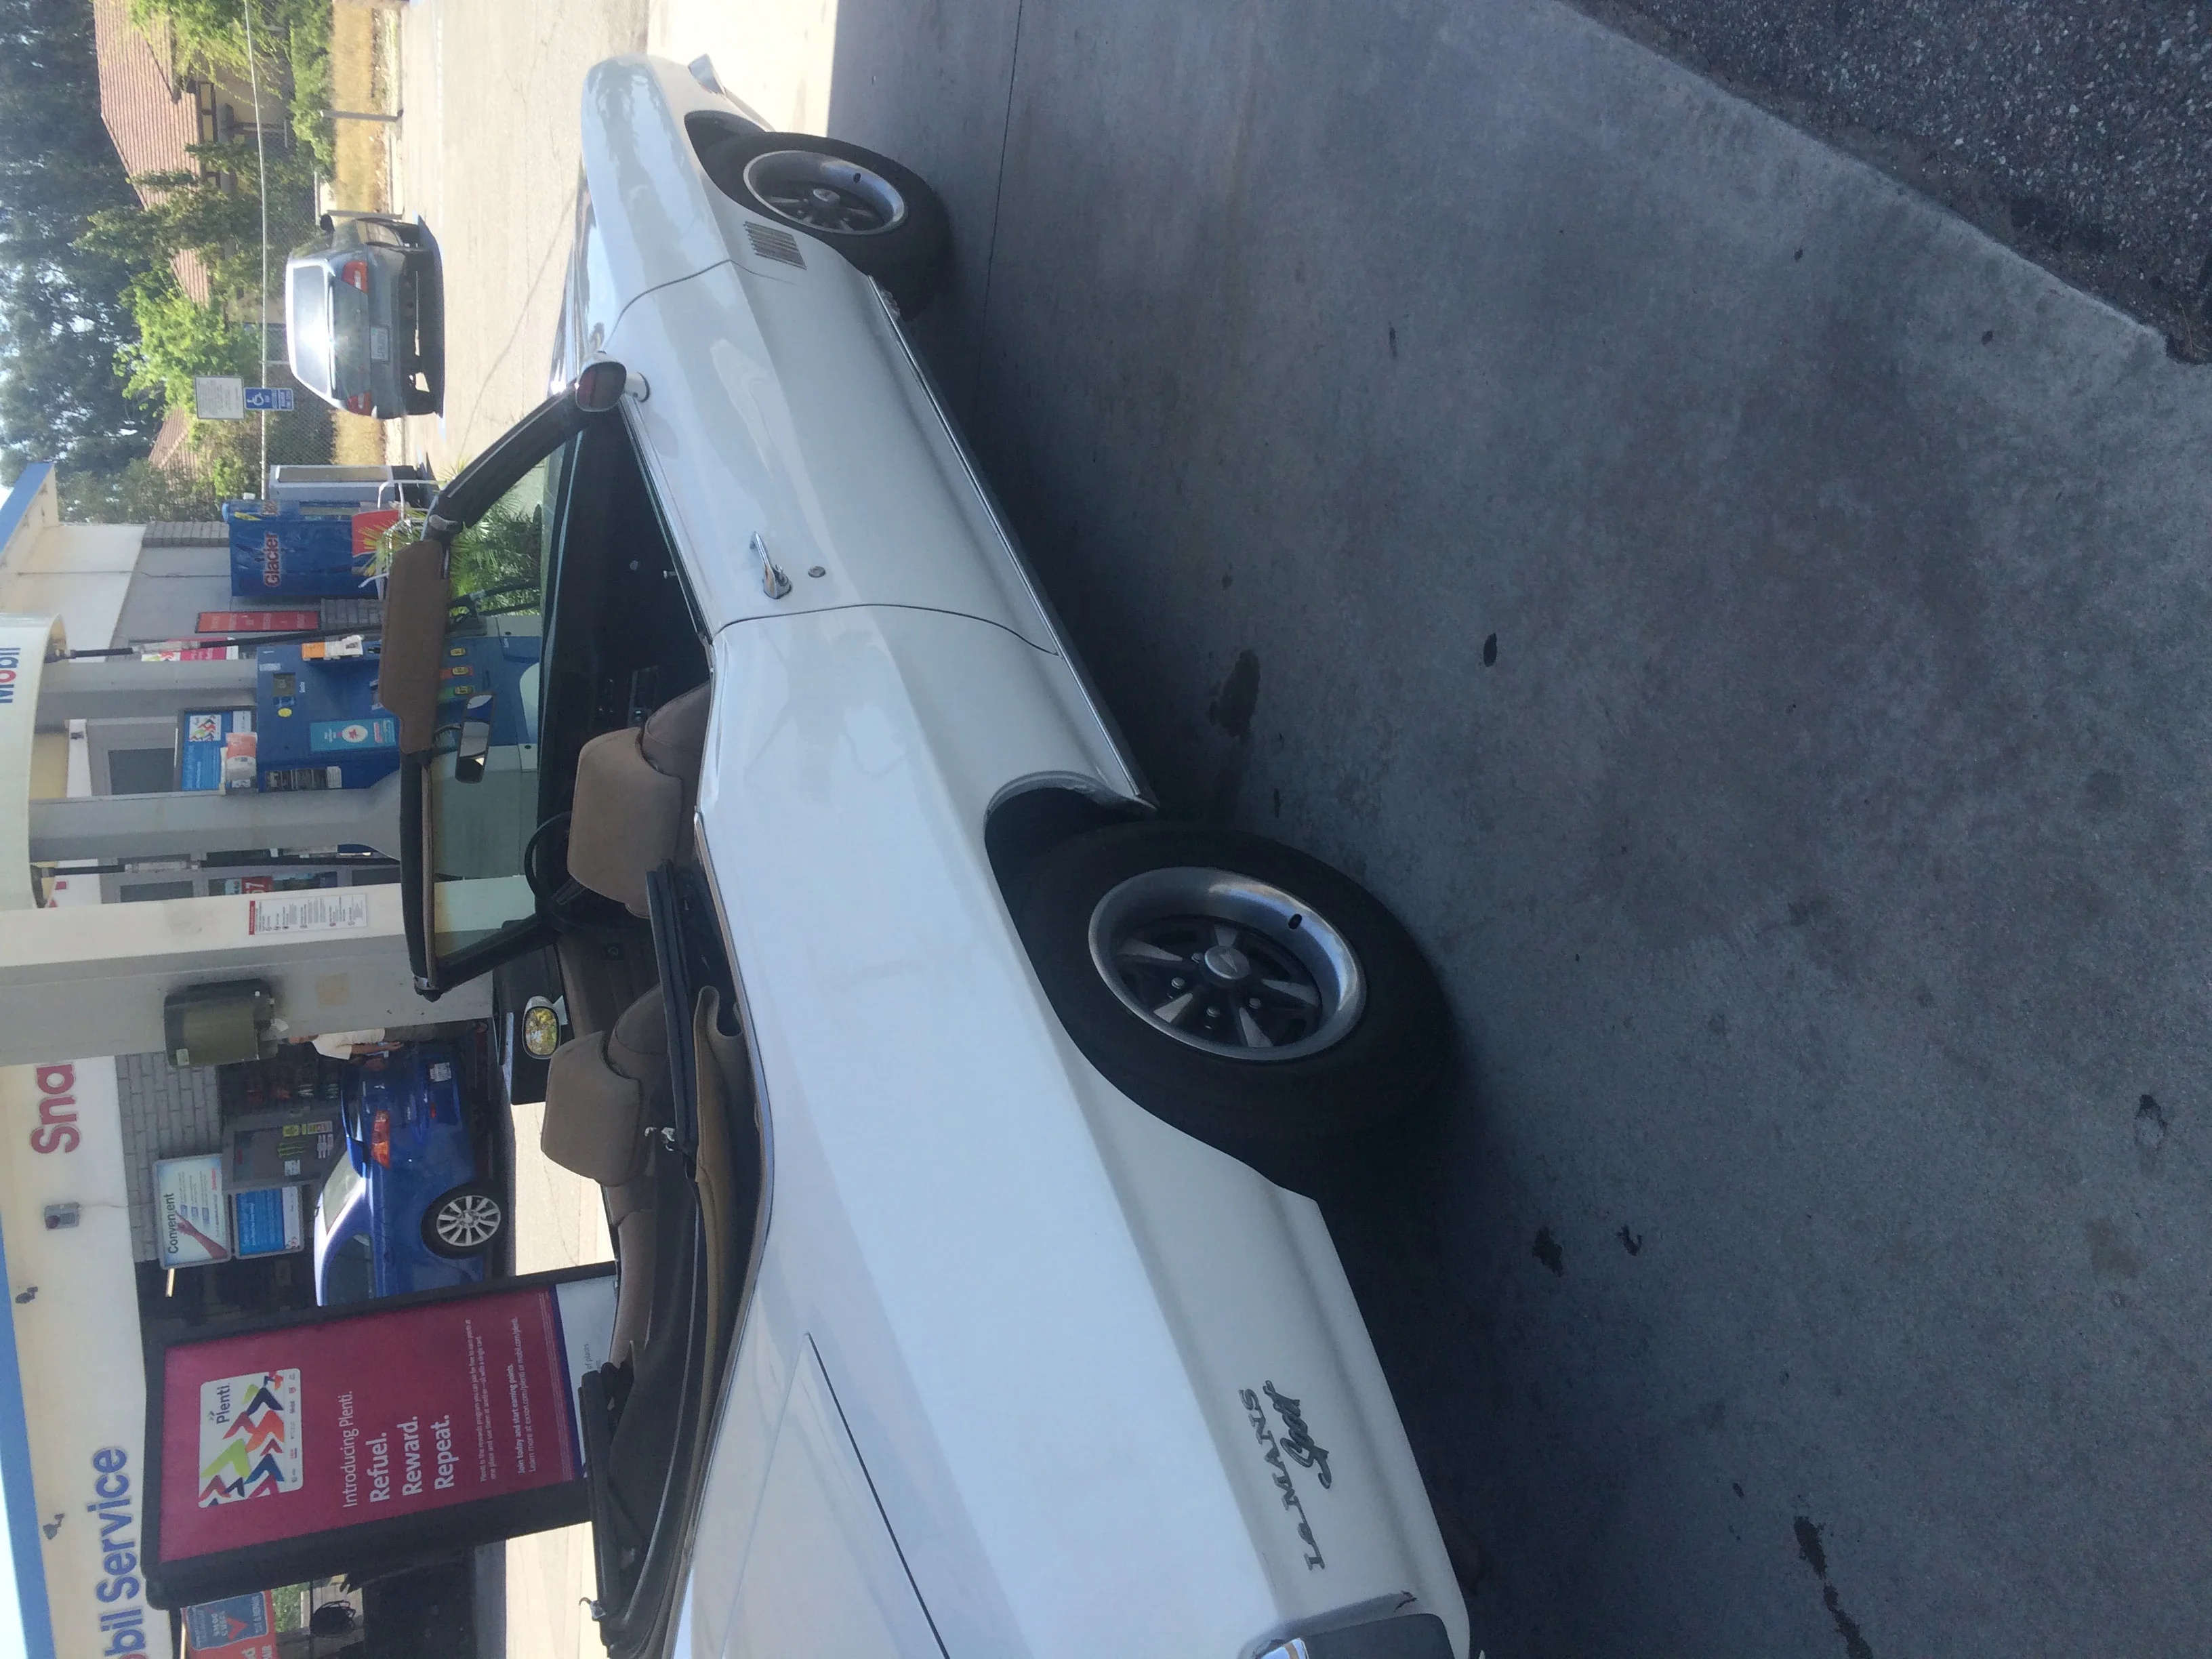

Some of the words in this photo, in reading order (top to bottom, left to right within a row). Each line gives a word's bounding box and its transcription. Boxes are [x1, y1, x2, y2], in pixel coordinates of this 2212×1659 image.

[263, 531, 281, 587] Glacier
[163, 1192, 179, 1254] Convenient
[583, 1343, 593, 1361] places
[506, 1363, 516, 1383] points.
[216, 1385, 231, 1425] Plenti
[337, 1390, 354, 1427] Plenti.
[508, 1384, 518, 1408] earning
[510, 1408, 520, 1424] start
[512, 1424, 522, 1437] and
[396, 1415, 423, 1496] Reward.
[430, 1414, 459, 1490] Repeat.
[514, 1439, 525, 1458] today
[526, 1433, 535, 1452] more
[1237, 1388, 1300, 1511] MANS
[340, 1428, 359, 1508] Introducing
[365, 1431, 391, 1502] Refuel.
[517, 1459, 526, 1473] Join
[528, 1452, 537, 1472] Learn
[86, 1448, 140, 1603] Service
[100, 1607, 150, 1659] bil
